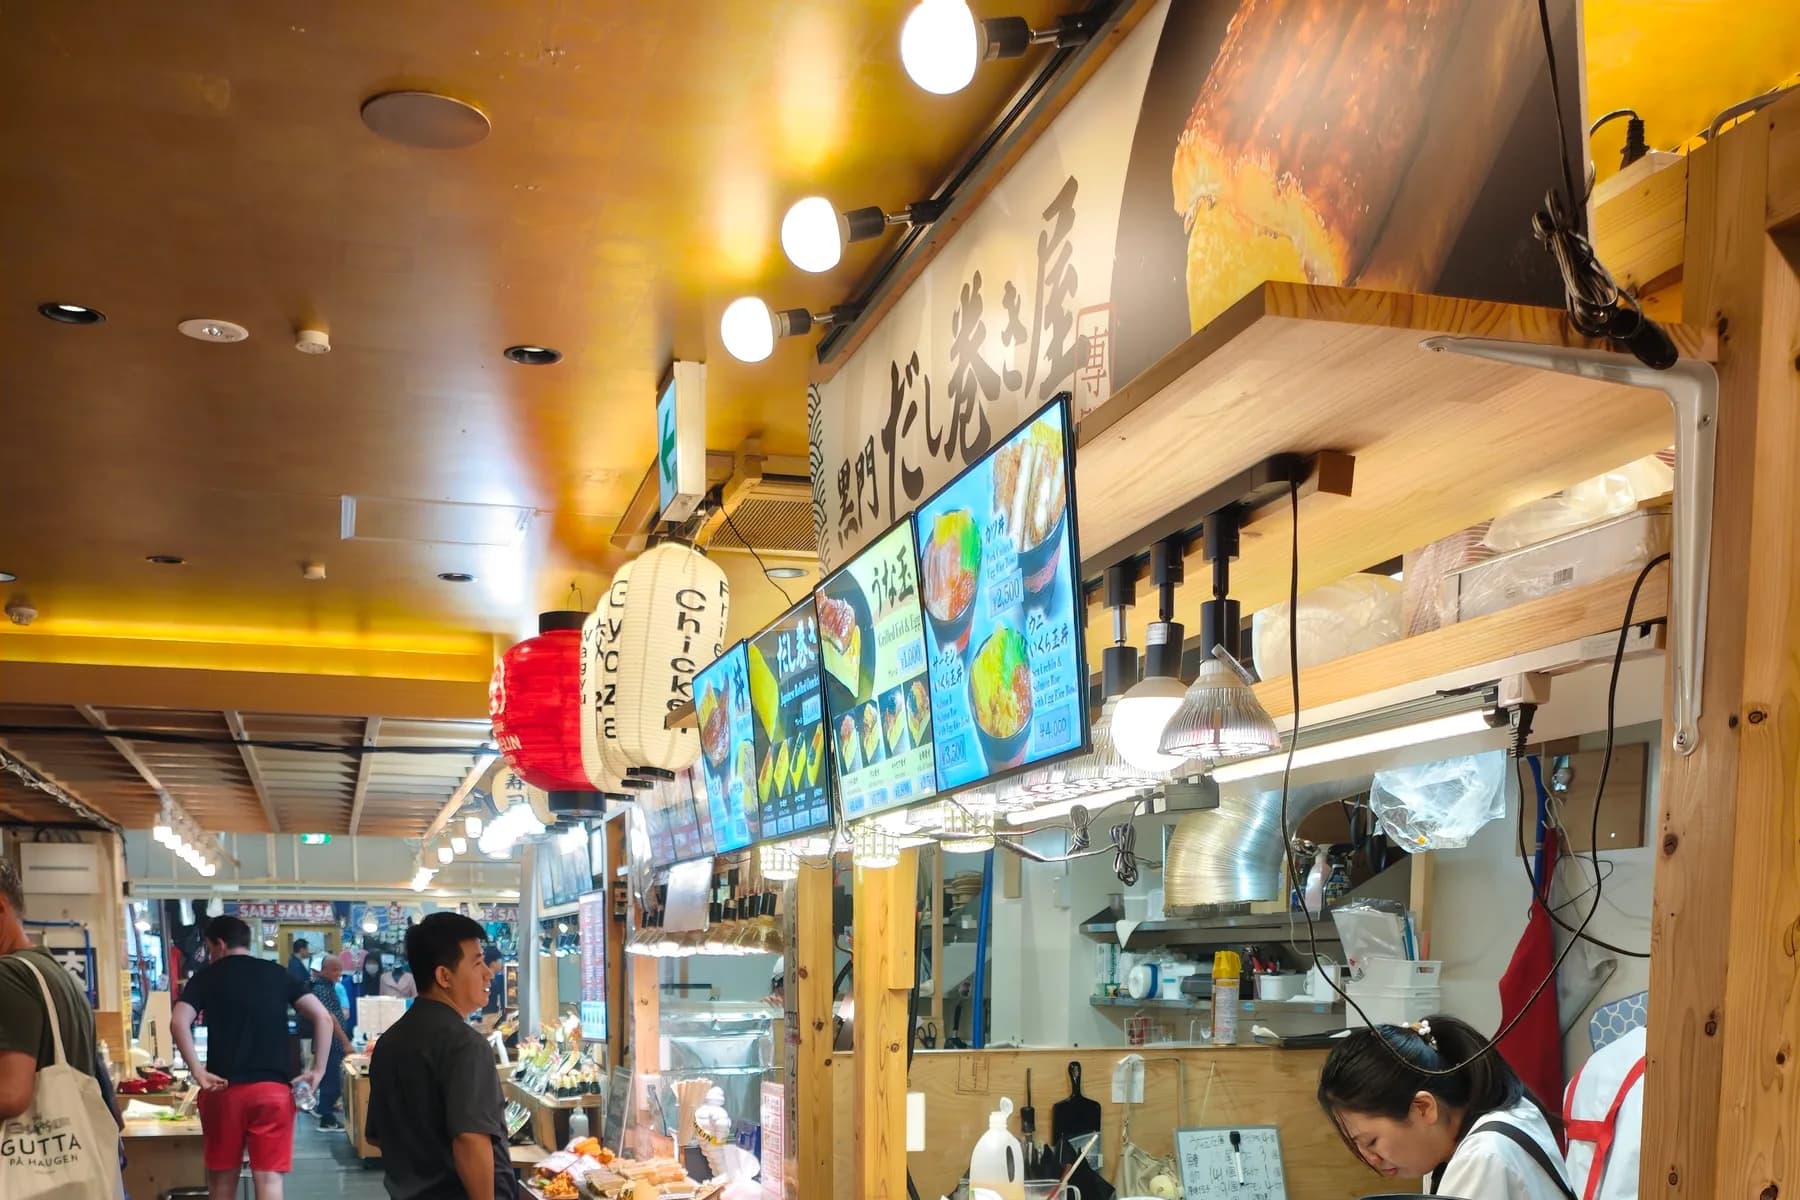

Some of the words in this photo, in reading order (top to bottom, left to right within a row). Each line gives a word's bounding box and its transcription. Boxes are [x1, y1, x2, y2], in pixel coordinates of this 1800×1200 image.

[837, 434, 880, 549] 黒門
[881, 174, 1092, 523] だし巻き屋
[664, 589, 707, 735] Chicke
[240, 904, 274, 918] SALE
[279, 903, 312, 918] SALE
[1, 1134, 82, 1157] GUTTA
[28, 1154, 78, 1167] HAUGEN
